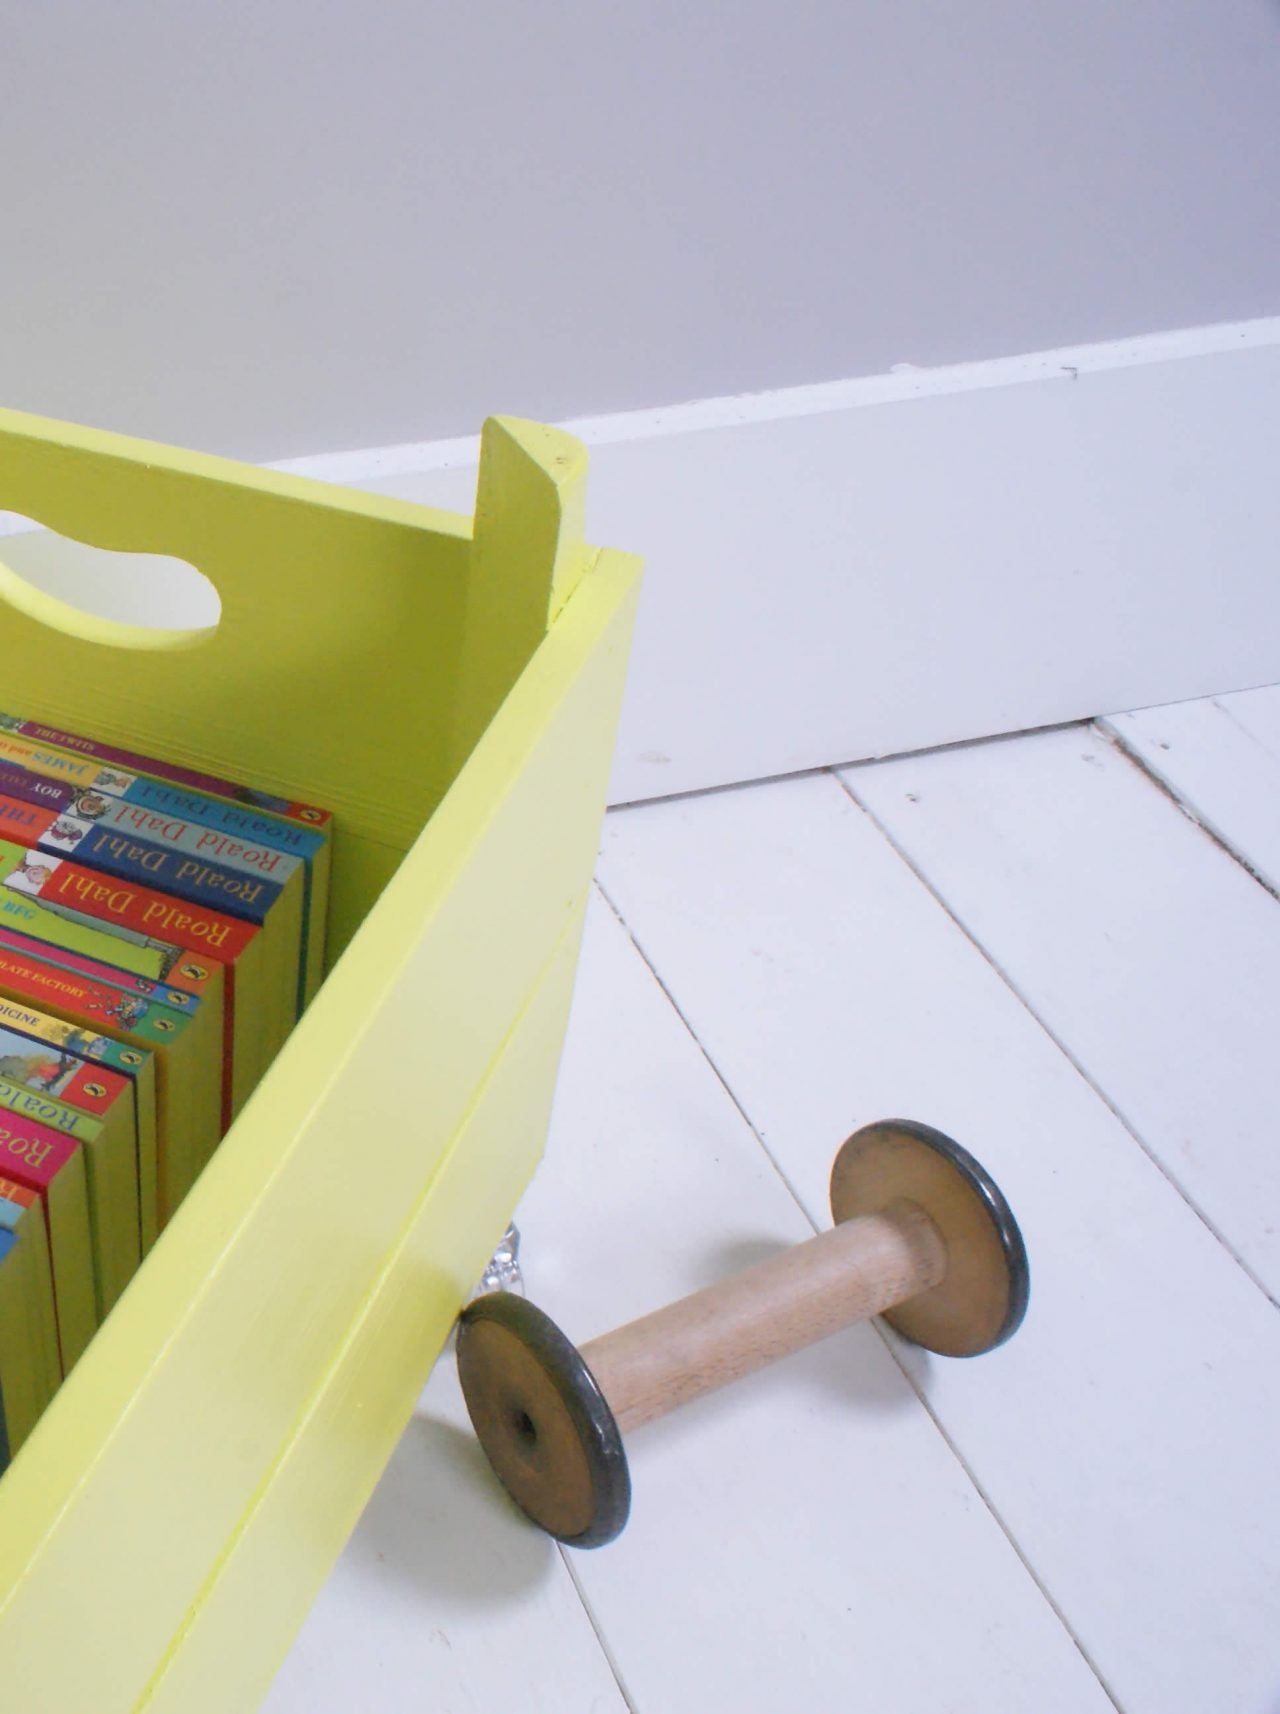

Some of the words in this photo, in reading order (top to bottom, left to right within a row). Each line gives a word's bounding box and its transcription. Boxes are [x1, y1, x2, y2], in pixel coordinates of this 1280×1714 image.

[35, 725, 57, 741] THE
[7, 746, 32, 755] and
[32, 751, 90, 775] JAMES
[30, 782, 63, 798] BOY
[141, 786, 207, 815] Dahl
[114, 806, 188, 842] Dahl
[223, 811, 301, 846] Roald
[93, 834, 170, 872] Dahl
[198, 831, 283, 873] Roald
[59, 873, 134, 914] Dahl
[176, 861, 265, 903] Roald
[4, 900, 36, 919] BFG
[142, 904, 235, 947] Roald
[32, 971, 88, 1000] FACTORY
